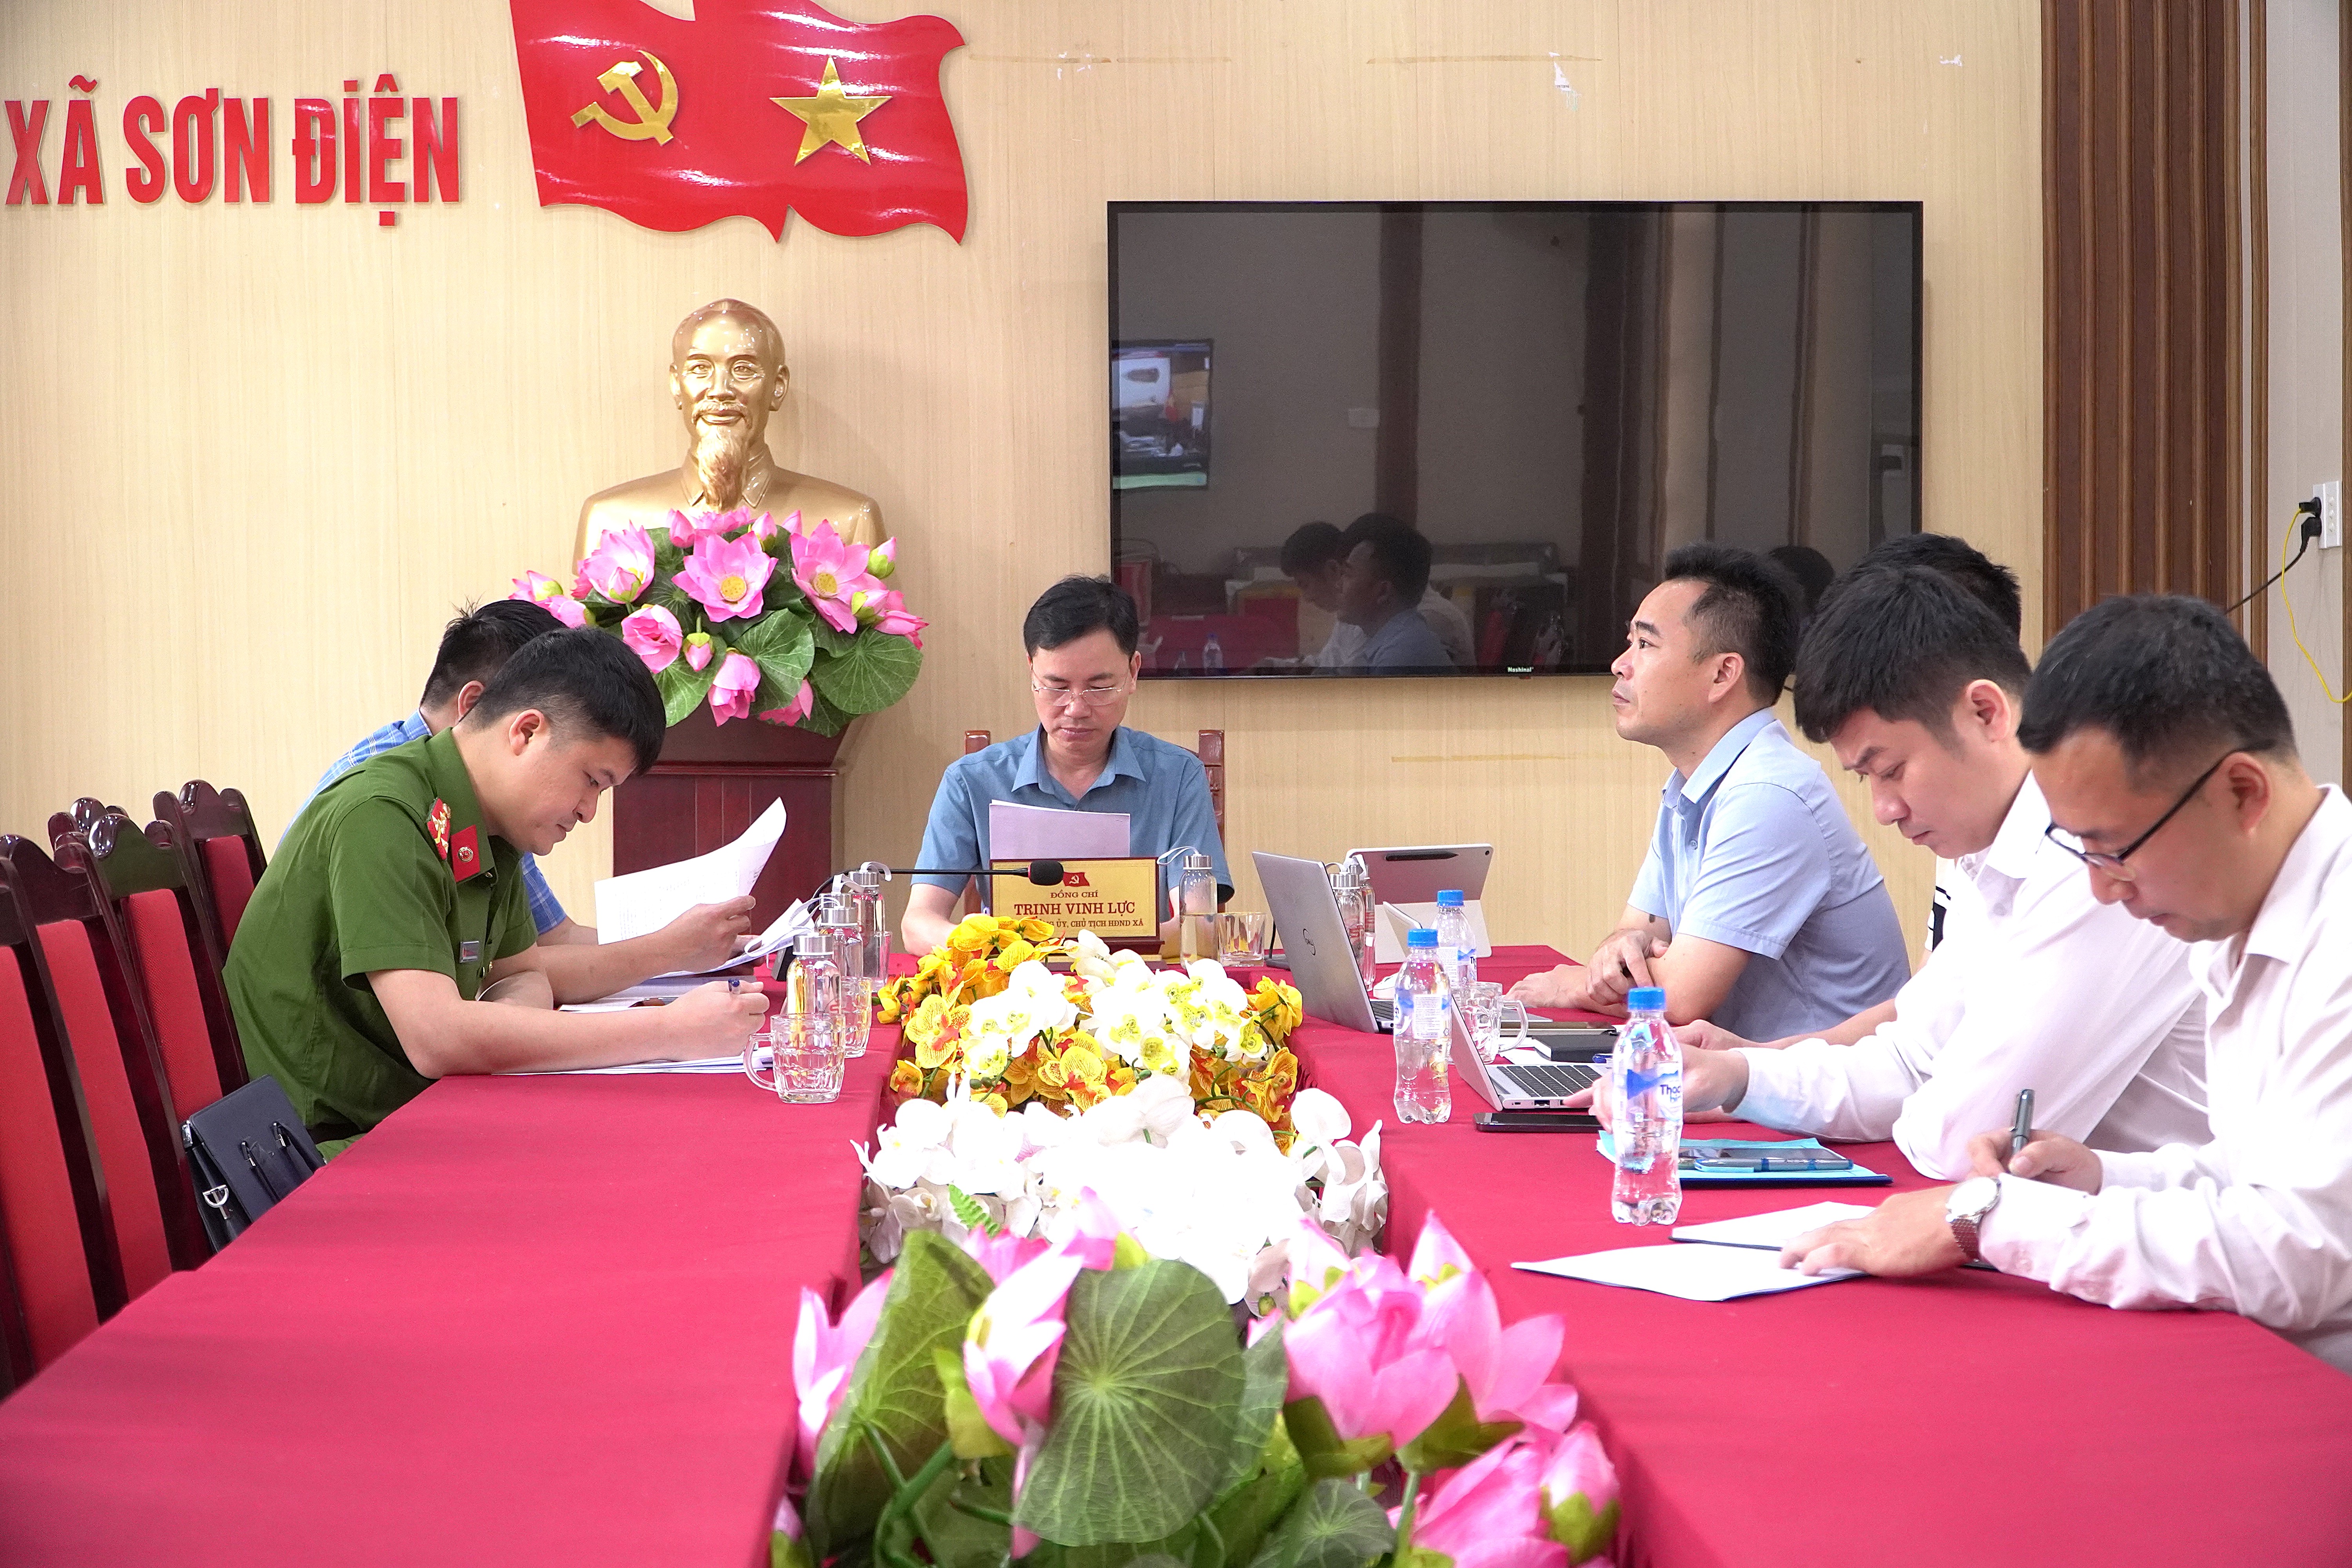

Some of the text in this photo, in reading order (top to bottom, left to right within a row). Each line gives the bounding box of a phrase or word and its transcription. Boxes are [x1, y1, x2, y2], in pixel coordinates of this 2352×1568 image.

[4, 75, 104, 205] XÃ
[123, 88, 270, 204] SƠN
[1050, 889, 1078, 898] ĐỒNG
[1065, 902, 1103, 915] VINH
[1108, 900, 1135, 916] LỰC
[1071, 918, 1086, 927] CHỦ
[1088, 920, 1106, 928] TỊCH
